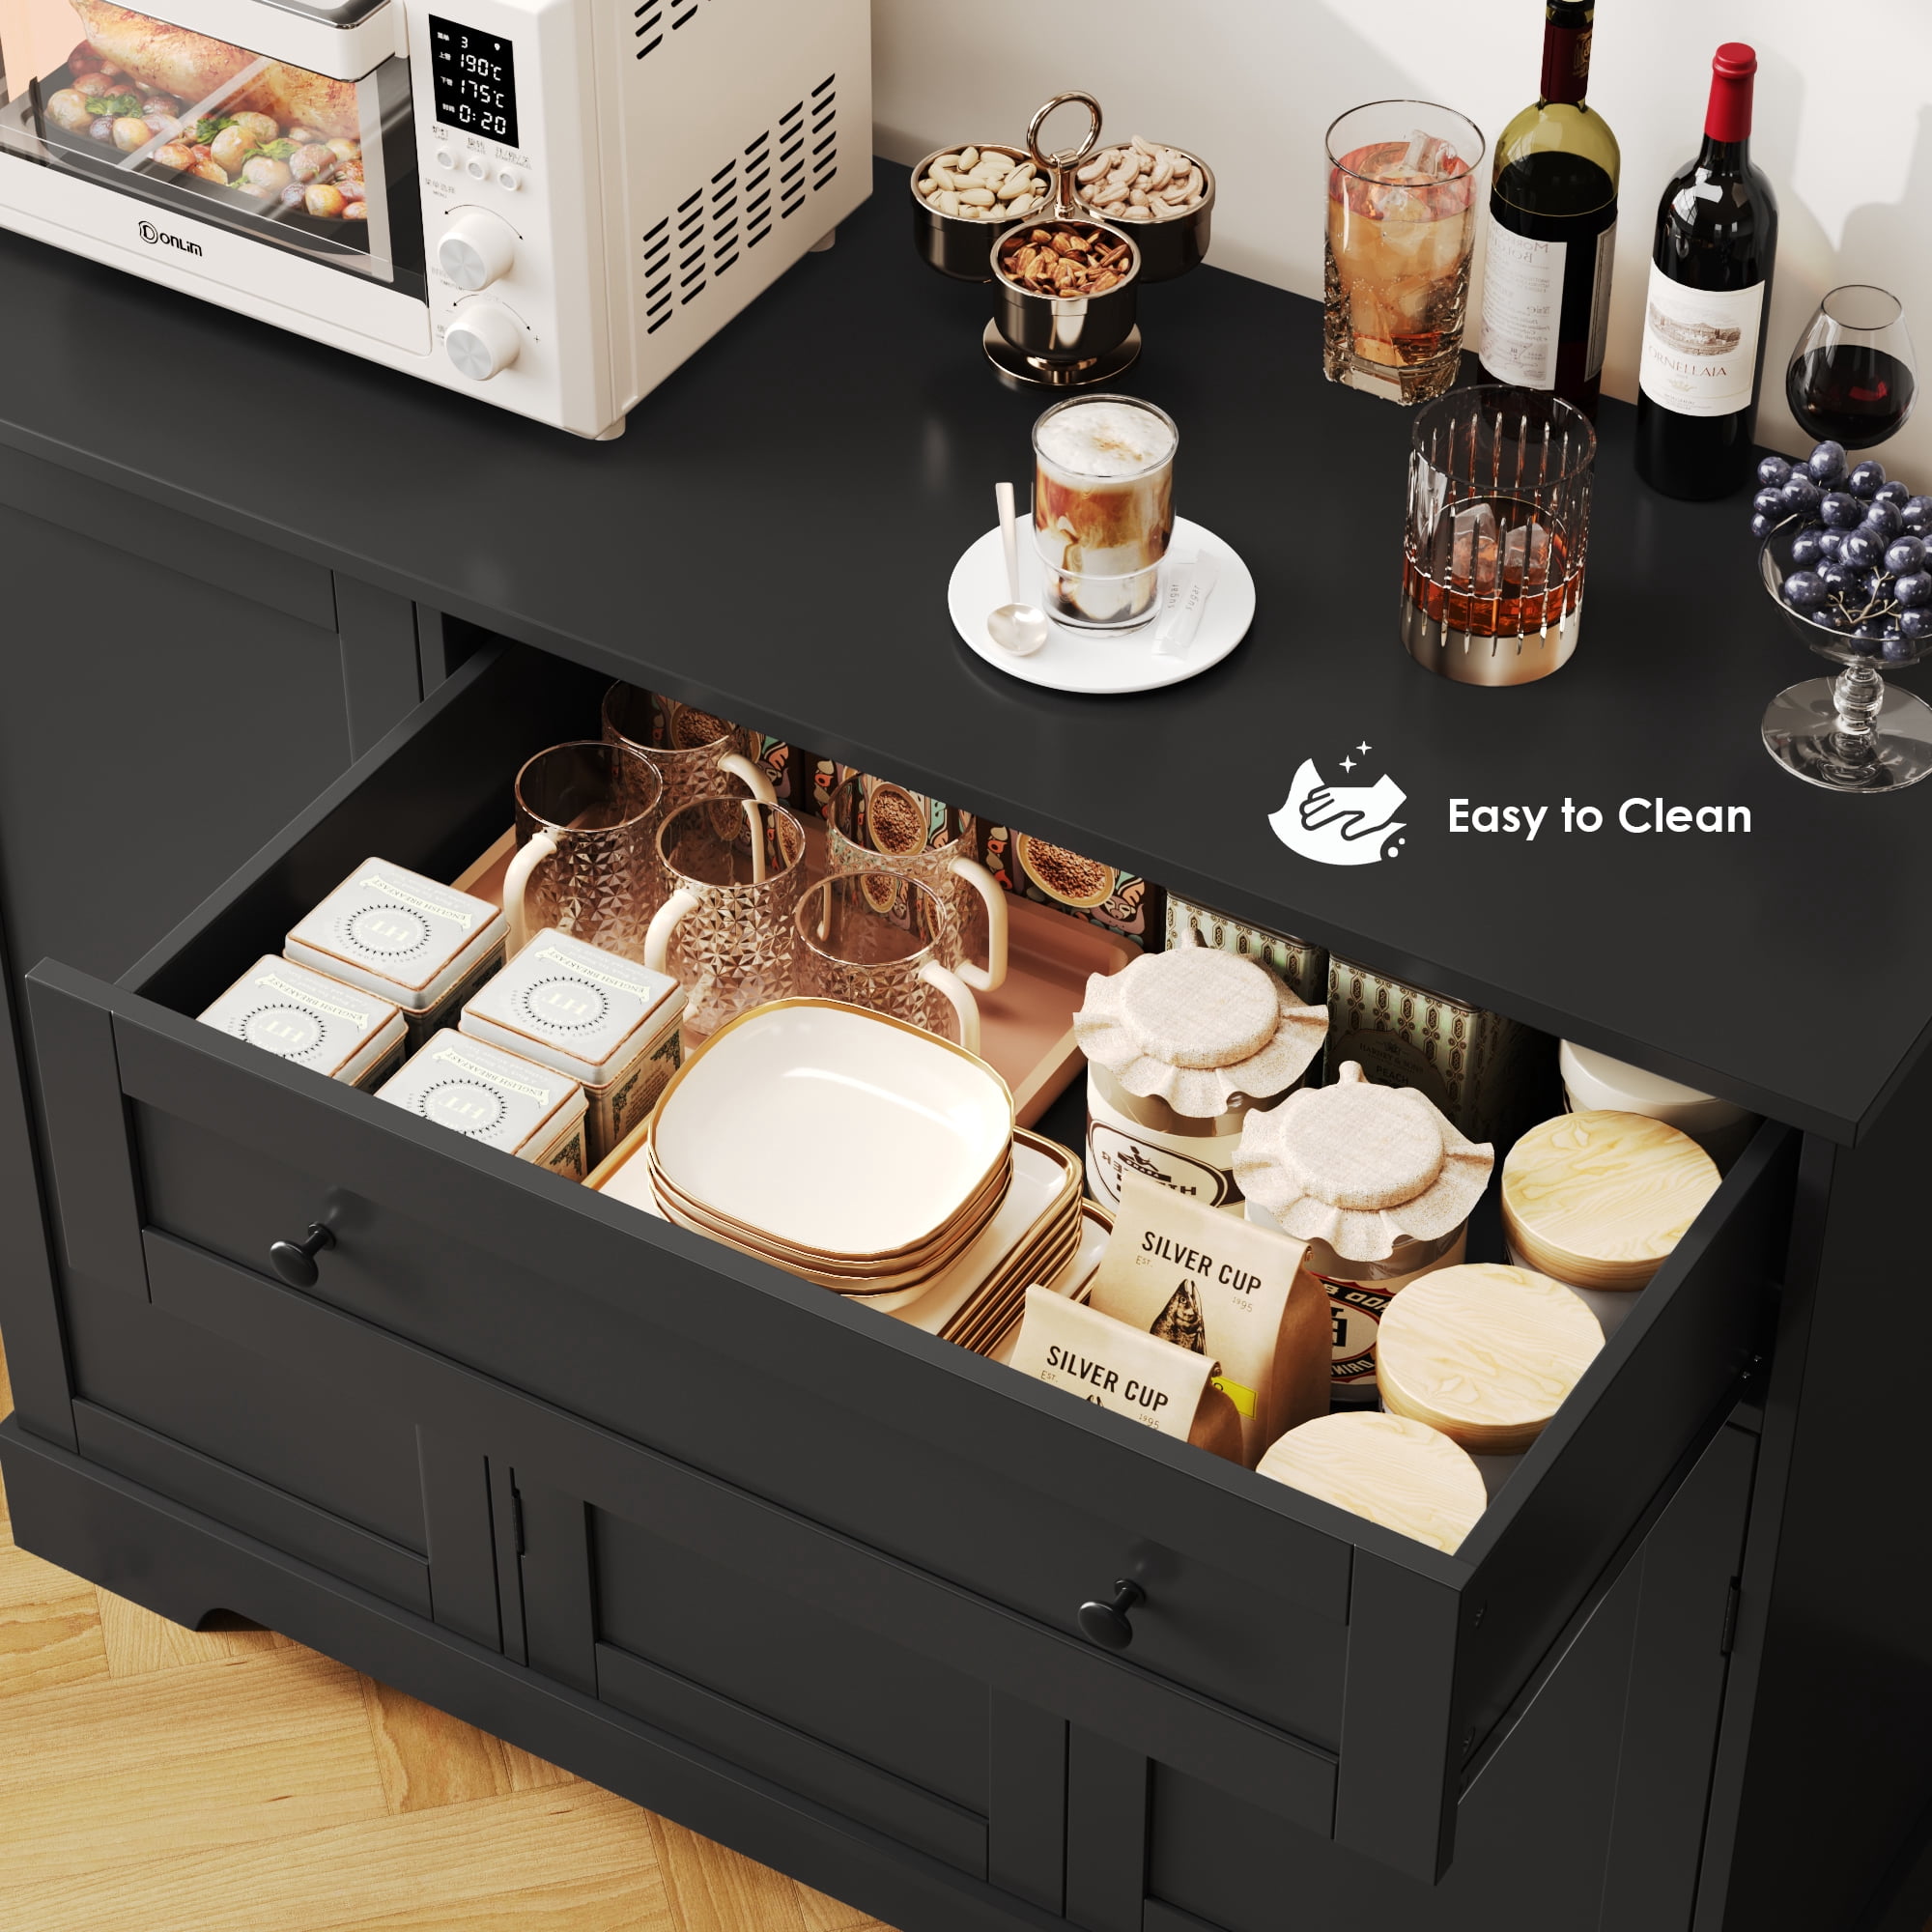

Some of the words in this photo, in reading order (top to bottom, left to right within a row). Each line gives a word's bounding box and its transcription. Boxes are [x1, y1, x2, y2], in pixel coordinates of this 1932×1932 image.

[1142, 1231, 1212, 1277] SILVER
[1218, 1264, 1262, 1294] CUP
[1046, 1346, 1119, 1393] SILVER
[1124, 1379, 1169, 1411] CUP
